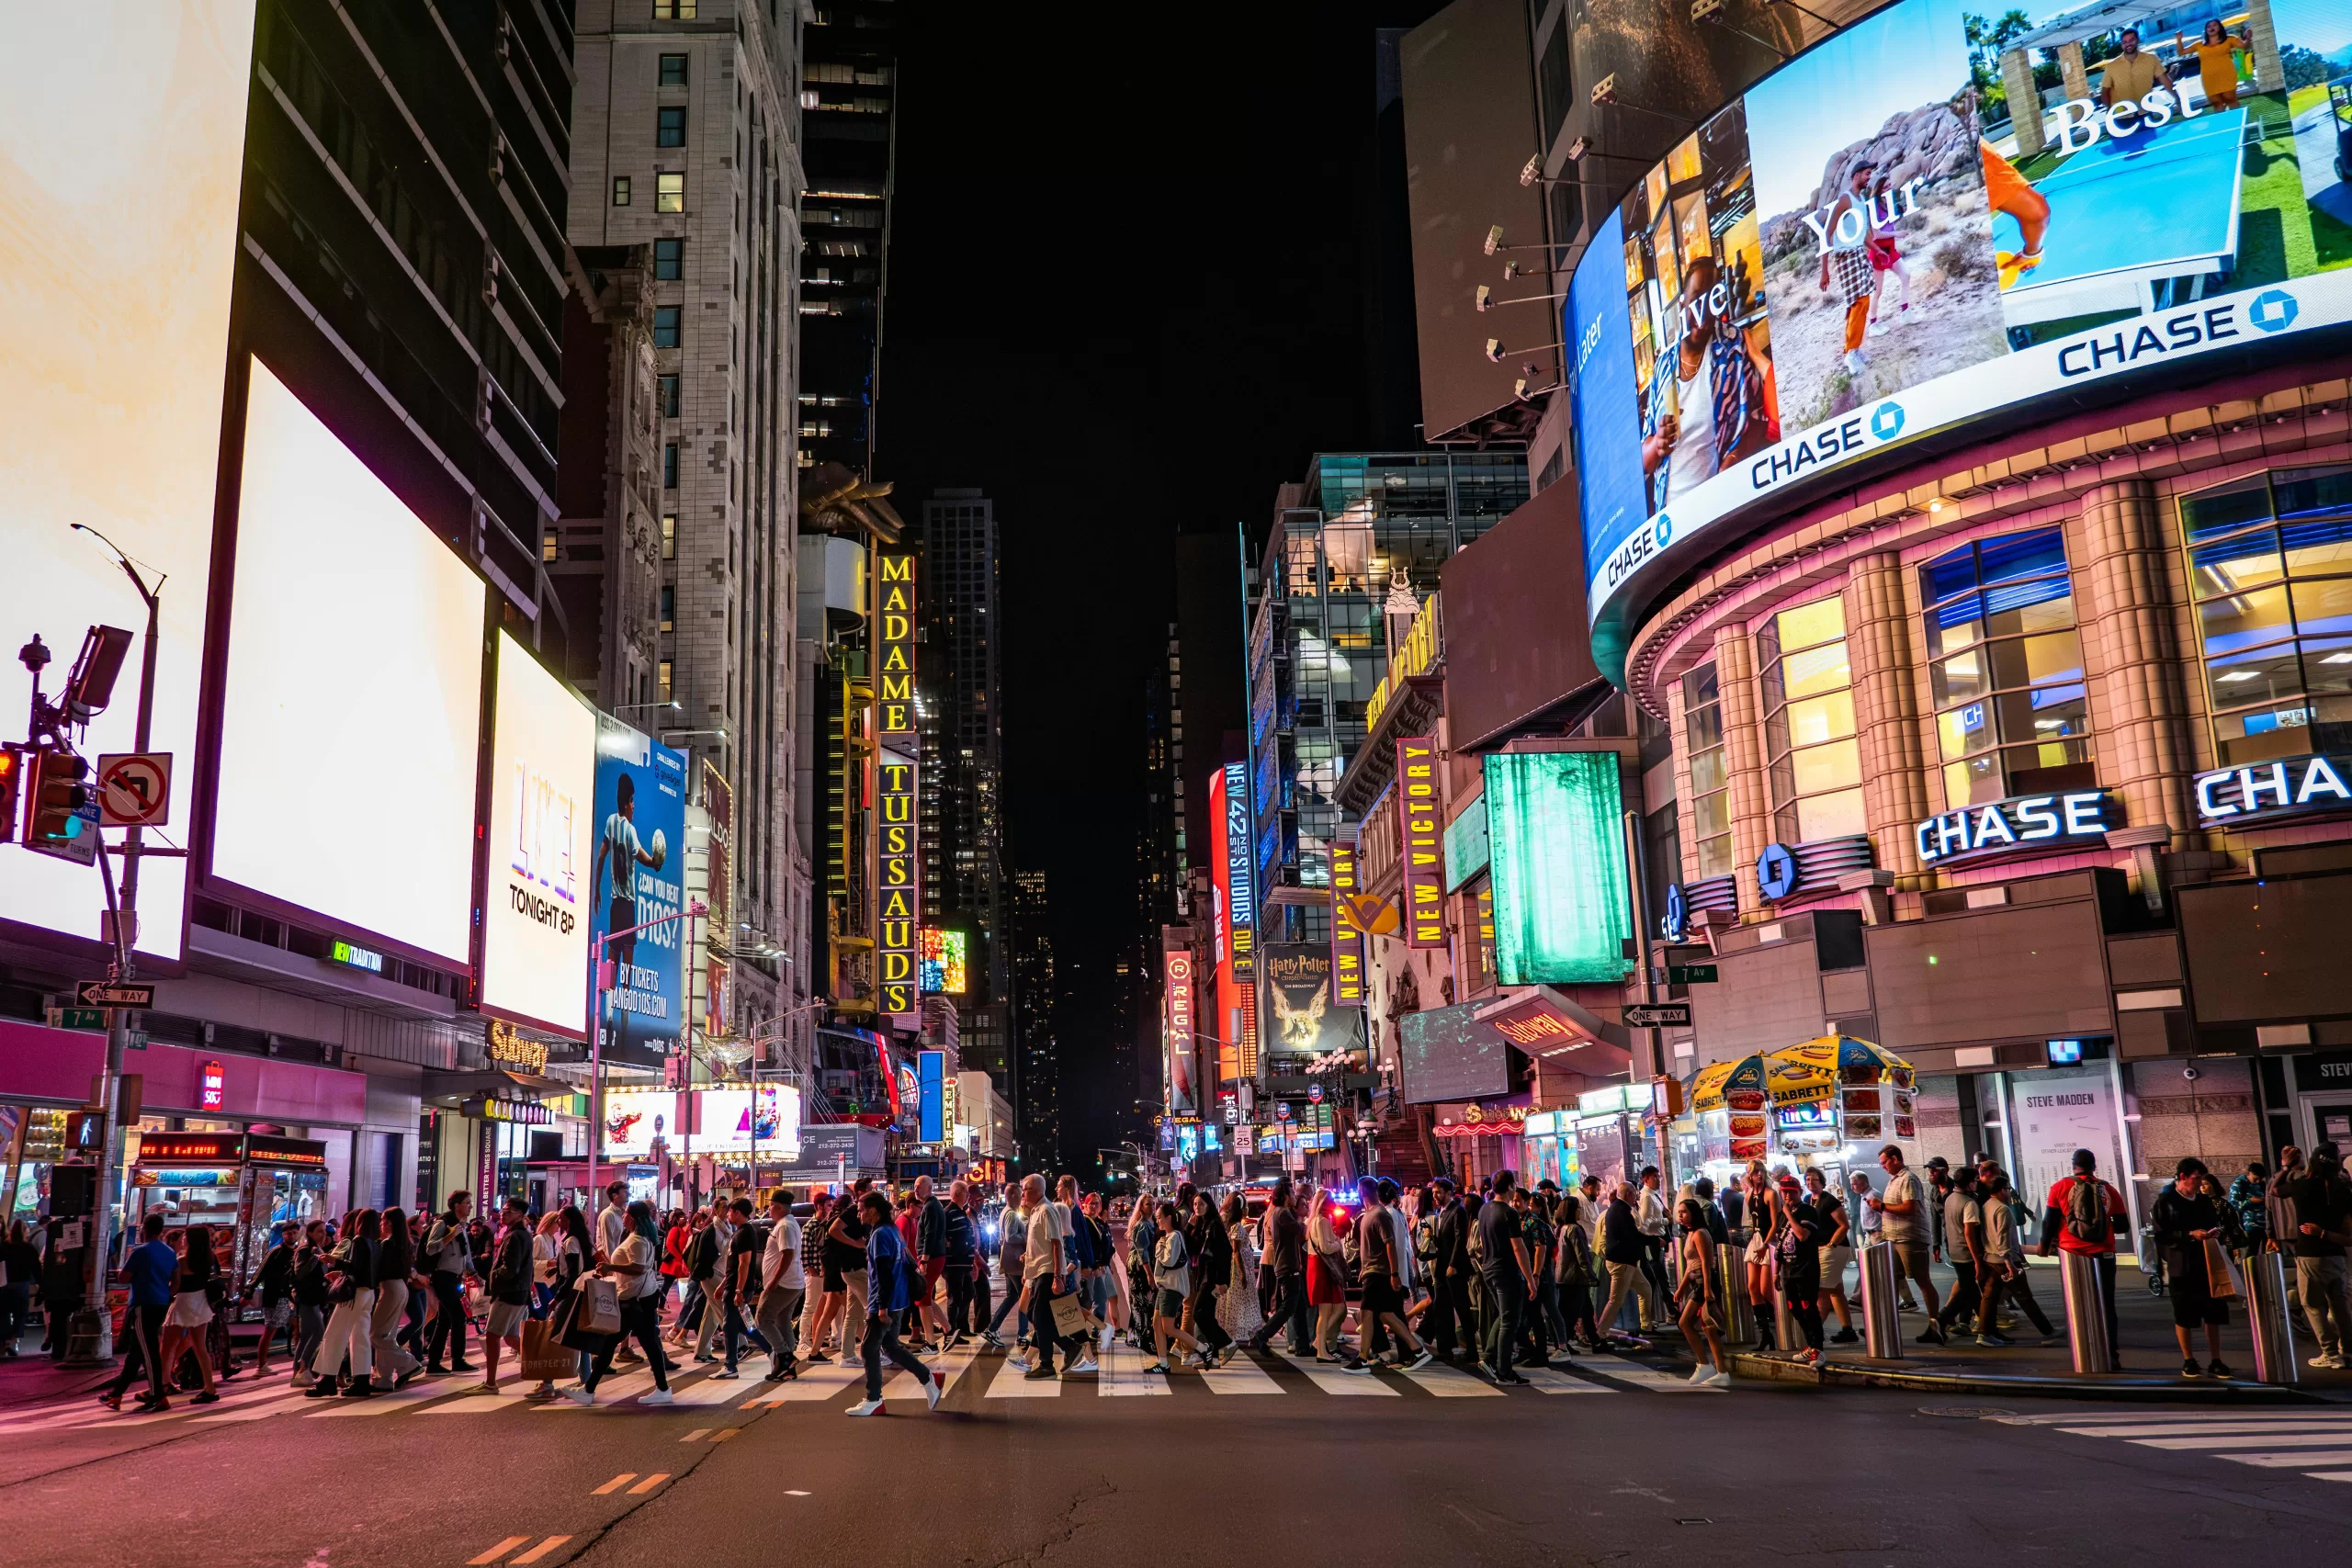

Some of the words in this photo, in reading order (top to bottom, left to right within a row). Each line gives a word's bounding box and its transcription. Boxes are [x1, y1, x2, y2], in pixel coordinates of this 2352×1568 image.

[2049, 77, 2202, 158] Best
[1801, 172, 1927, 259] Your
[1577, 310, 1602, 375] Later
[1654, 281, 1728, 355] Live
[2058, 305, 2239, 378] CHASE
[1752, 418, 1865, 490] CHASE
[1608, 527, 1655, 588] CHASE
[880, 557, 911, 730] MADAME
[1366, 677, 1385, 734] NEW
[1226, 763, 1245, 797] NEW
[1406, 745, 1437, 866] VICTORY
[2198, 757, 2352, 817] CHA
[1229, 837, 1238, 856] ST
[1917, 792, 2109, 861] CHASE
[510, 883, 560, 930] TONIGHT
[560, 910, 575, 936] 8P
[655, 878, 666, 900] YOU
[666, 882, 680, 905] BEAT
[884, 765, 910, 1012] TUSSAUD'S
[1230, 857, 1251, 923] STUDIOS
[1415, 884, 1442, 942] NEW
[638, 895, 680, 950] D10S?
[1234, 930, 1252, 968] DUKE
[620, 962, 630, 986] BY
[631, 964, 659, 992] TICKETS
[1174, 964, 1184, 973] R
[1268, 957, 1298, 977] Harry
[1298, 954, 1329, 979] Potter
[1339, 953, 1360, 999] NEW
[1682, 968, 1689, 981] 7
[74, 1011, 81, 1026] 7
[88, 989, 109, 1000] ONE
[120, 991, 143, 1001] WAY
[613, 987, 667, 1019] ANGOD10S.COM
[1173, 986, 1190, 1055] REGAL
[1632, 1011, 1652, 1021] ONE
[1661, 1010, 1681, 1020] WAY
[492, 1021, 549, 1076] Subway
[1495, 1012, 1574, 1044] Subway
[1773, 1084, 1830, 1103] SABRETT
[2321, 1063, 2352, 1077] STEV
[945, 1090, 954, 1148] EMPIRE
[2027, 1095, 2054, 1108] STEVE
[2055, 1093, 2095, 1107] MADDEN
[1237, 1137, 1250, 1145] 25
[1299, 1139, 1314, 1147] $23
